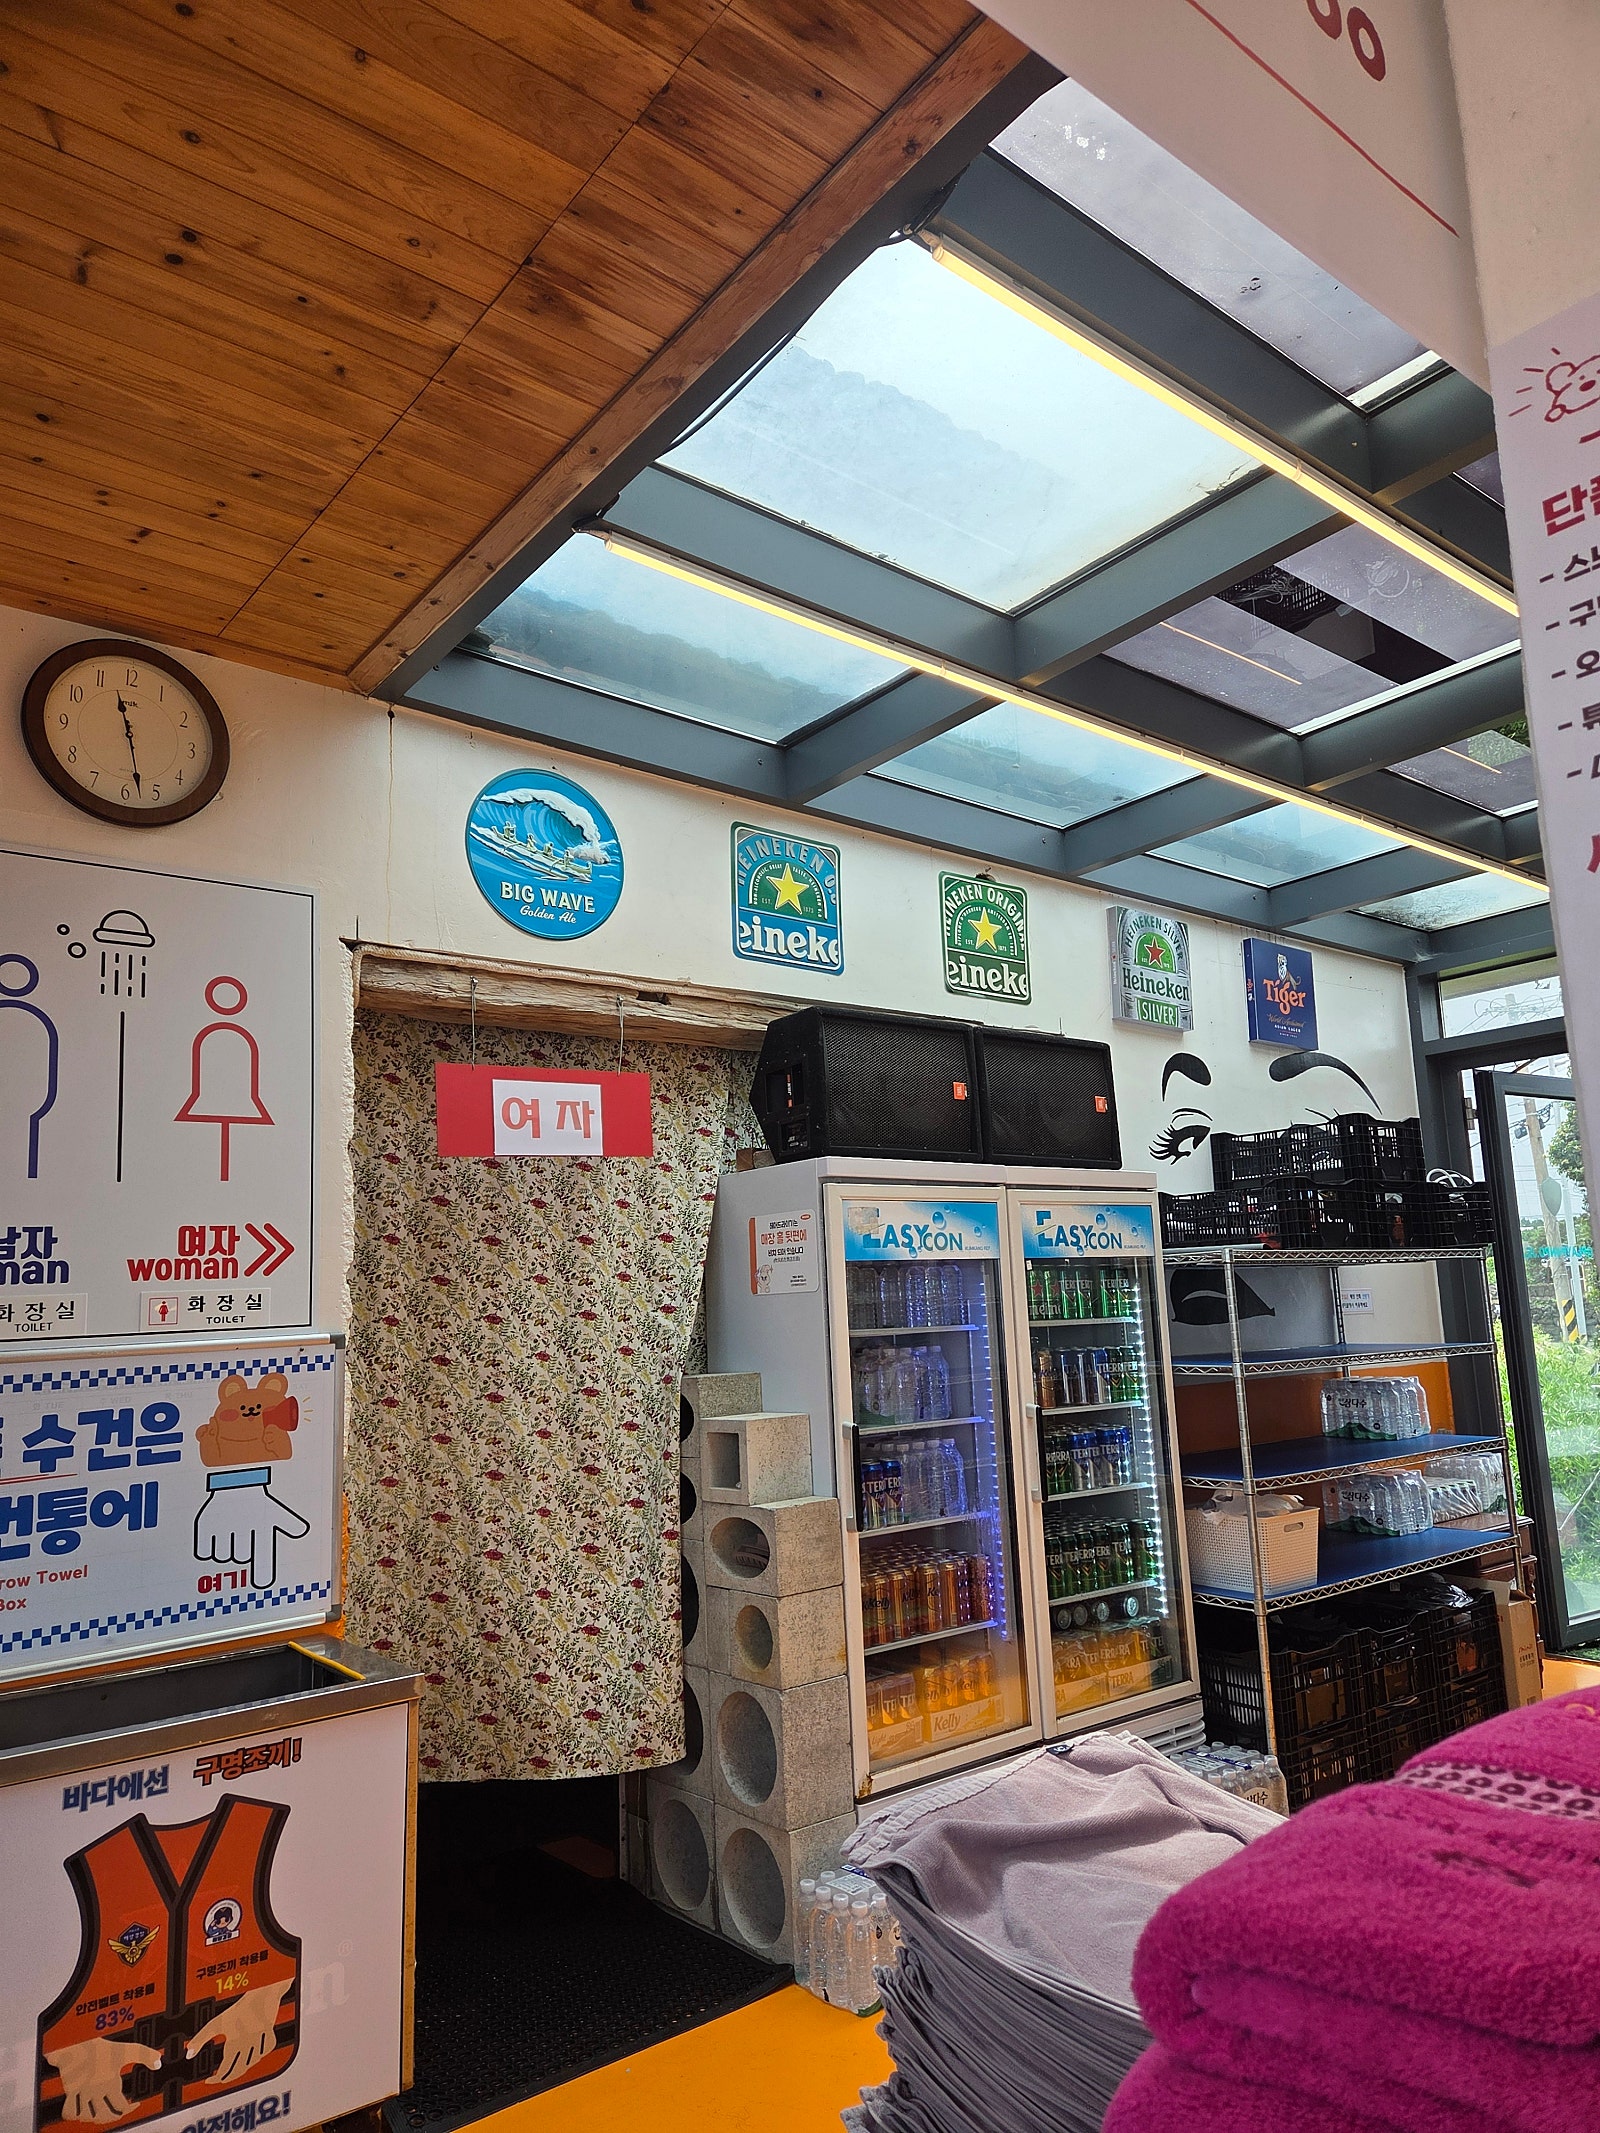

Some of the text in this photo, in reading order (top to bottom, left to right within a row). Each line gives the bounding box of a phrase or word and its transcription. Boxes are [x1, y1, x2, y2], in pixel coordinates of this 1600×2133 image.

[96, 670, 105, 688] 11
[126, 669, 138, 688] 12
[69, 684, 83, 703] 10
[159, 685, 164, 702] 1
[59, 713, 69, 730] 9
[179, 711, 188, 728] 2
[67, 745, 77, 763] 8
[187, 742, 196, 759] 3
[90, 770, 99, 788] 7
[175, 769, 184, 786] 4
[120, 783, 130, 800] 6
[152, 783, 160, 801] 5
[501, 881, 596, 913] BIG WAVE
[520, 904, 577, 924] Golden Ale
[1125, 914, 1184, 960] HEINEKEN SILVER
[1122, 967, 1190, 1001] Heineken
[1263, 978, 1306, 1015] Tiger
[1142, 1001, 1175, 1025] SILVER
[862, 1208, 964, 1251] ASYCON
[177, 1225, 240, 1257] 여자
[127, 1257, 239, 1282] woman
[14, 1321, 53, 1333] TOILET
[206, 1315, 246, 1325] TOILET
[22, 1402, 184, 1473] 수건은
[36, 1564, 88, 1584] Towel
[197, 1568, 248, 1594] 여기
[934, 1713, 960, 1733] Kelly
[62, 1737, 303, 1813] 바다에선 구명조끼!
[196, 1958, 237, 1981] 구명조끼
[216, 1970, 249, 1994] 14%
[95, 2004, 135, 2031] 83%
